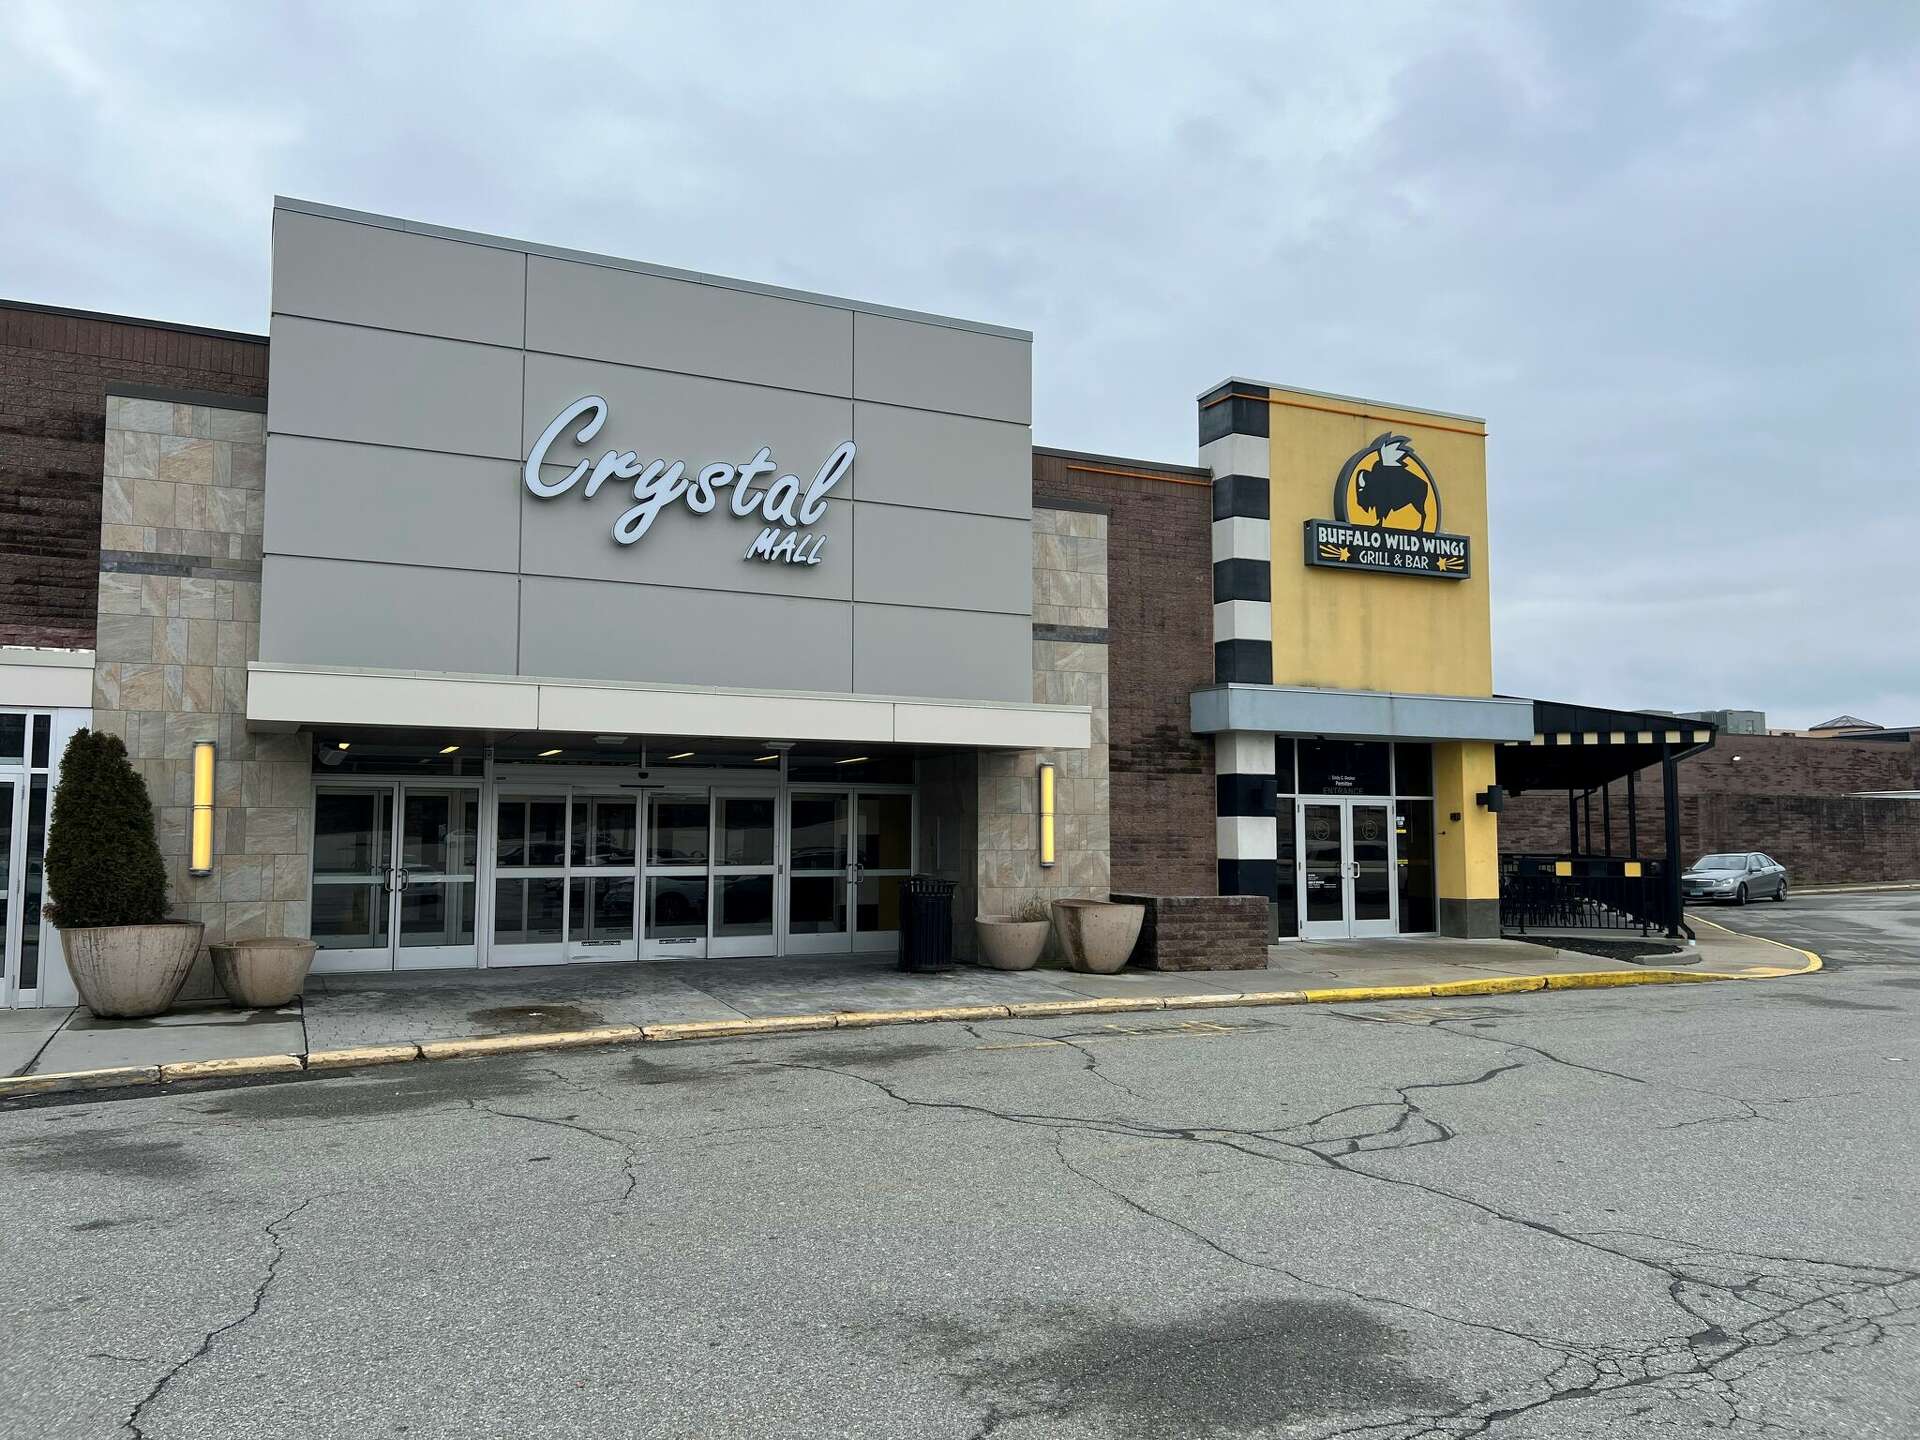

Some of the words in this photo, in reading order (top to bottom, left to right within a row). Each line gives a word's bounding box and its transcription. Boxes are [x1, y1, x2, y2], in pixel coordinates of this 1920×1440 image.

[524, 395, 857, 545] Crystal
[744, 527, 827, 565] MALL
[1318, 526, 1381, 548] BUFFALO
[1384, 533, 1419, 552] WILD
[1422, 537, 1465, 556] WINGS
[1359, 550, 1390, 566] GRILL
[1393, 554, 1402, 567] &
[1405, 555, 1429, 570] BAR
